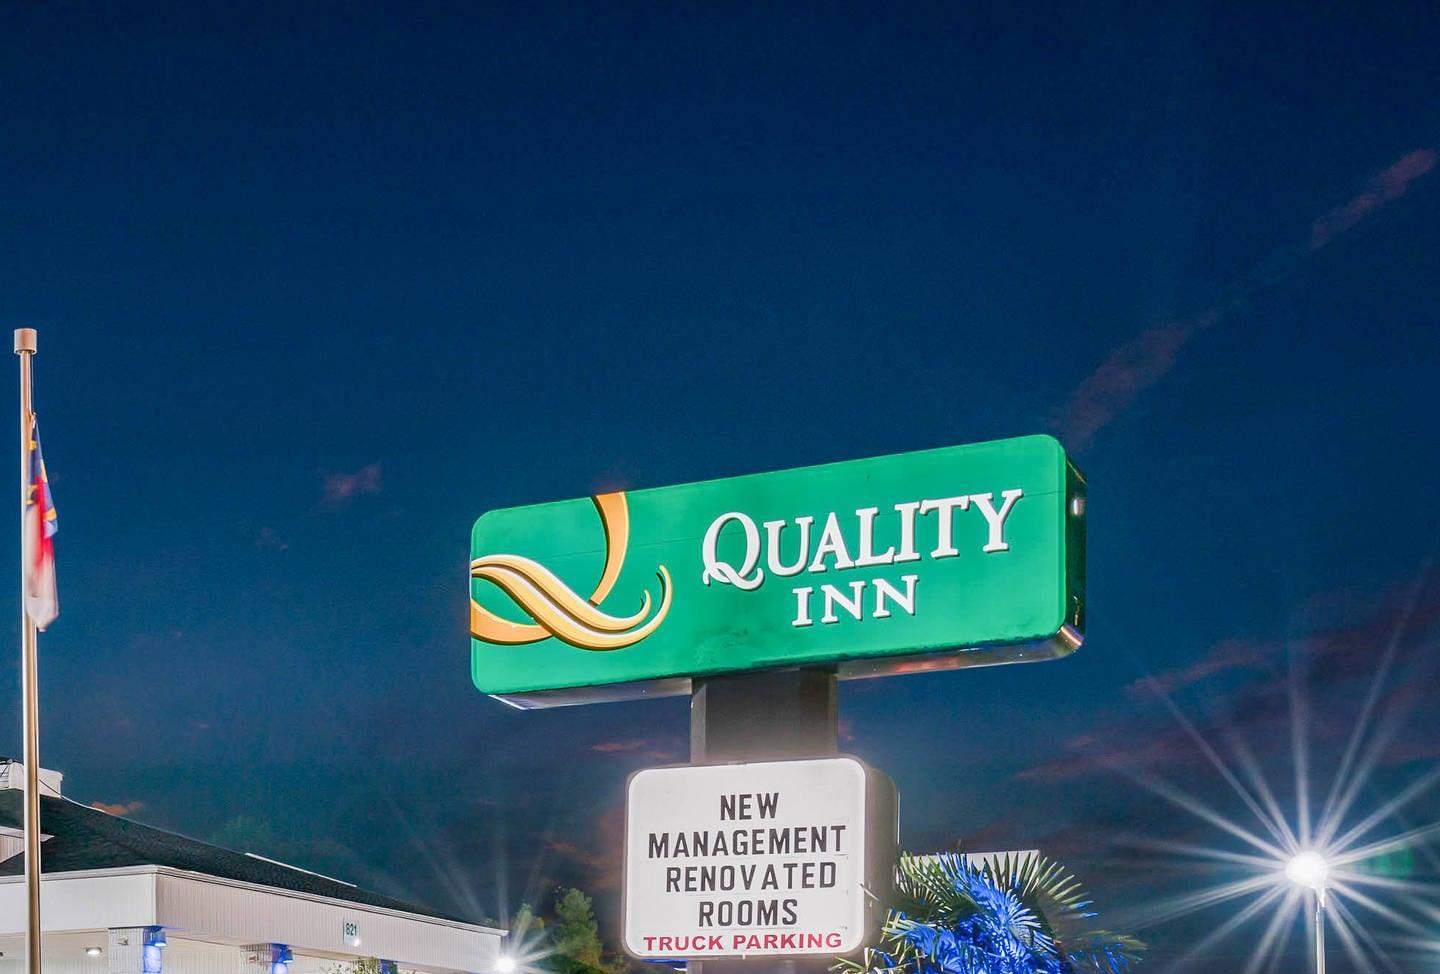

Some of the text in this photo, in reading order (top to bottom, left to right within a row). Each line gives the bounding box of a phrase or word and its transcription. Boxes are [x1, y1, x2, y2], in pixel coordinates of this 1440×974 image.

[702, 488, 1024, 591] QUALITY
[792, 574, 920, 626] INN
[720, 792, 779, 821] NEW
[648, 825, 846, 859] MANAGEMENT
[665, 861, 837, 892] RENOVATED
[698, 898, 798, 927] ROOMS
[643, 932, 843, 951] TRUCK PARKING
